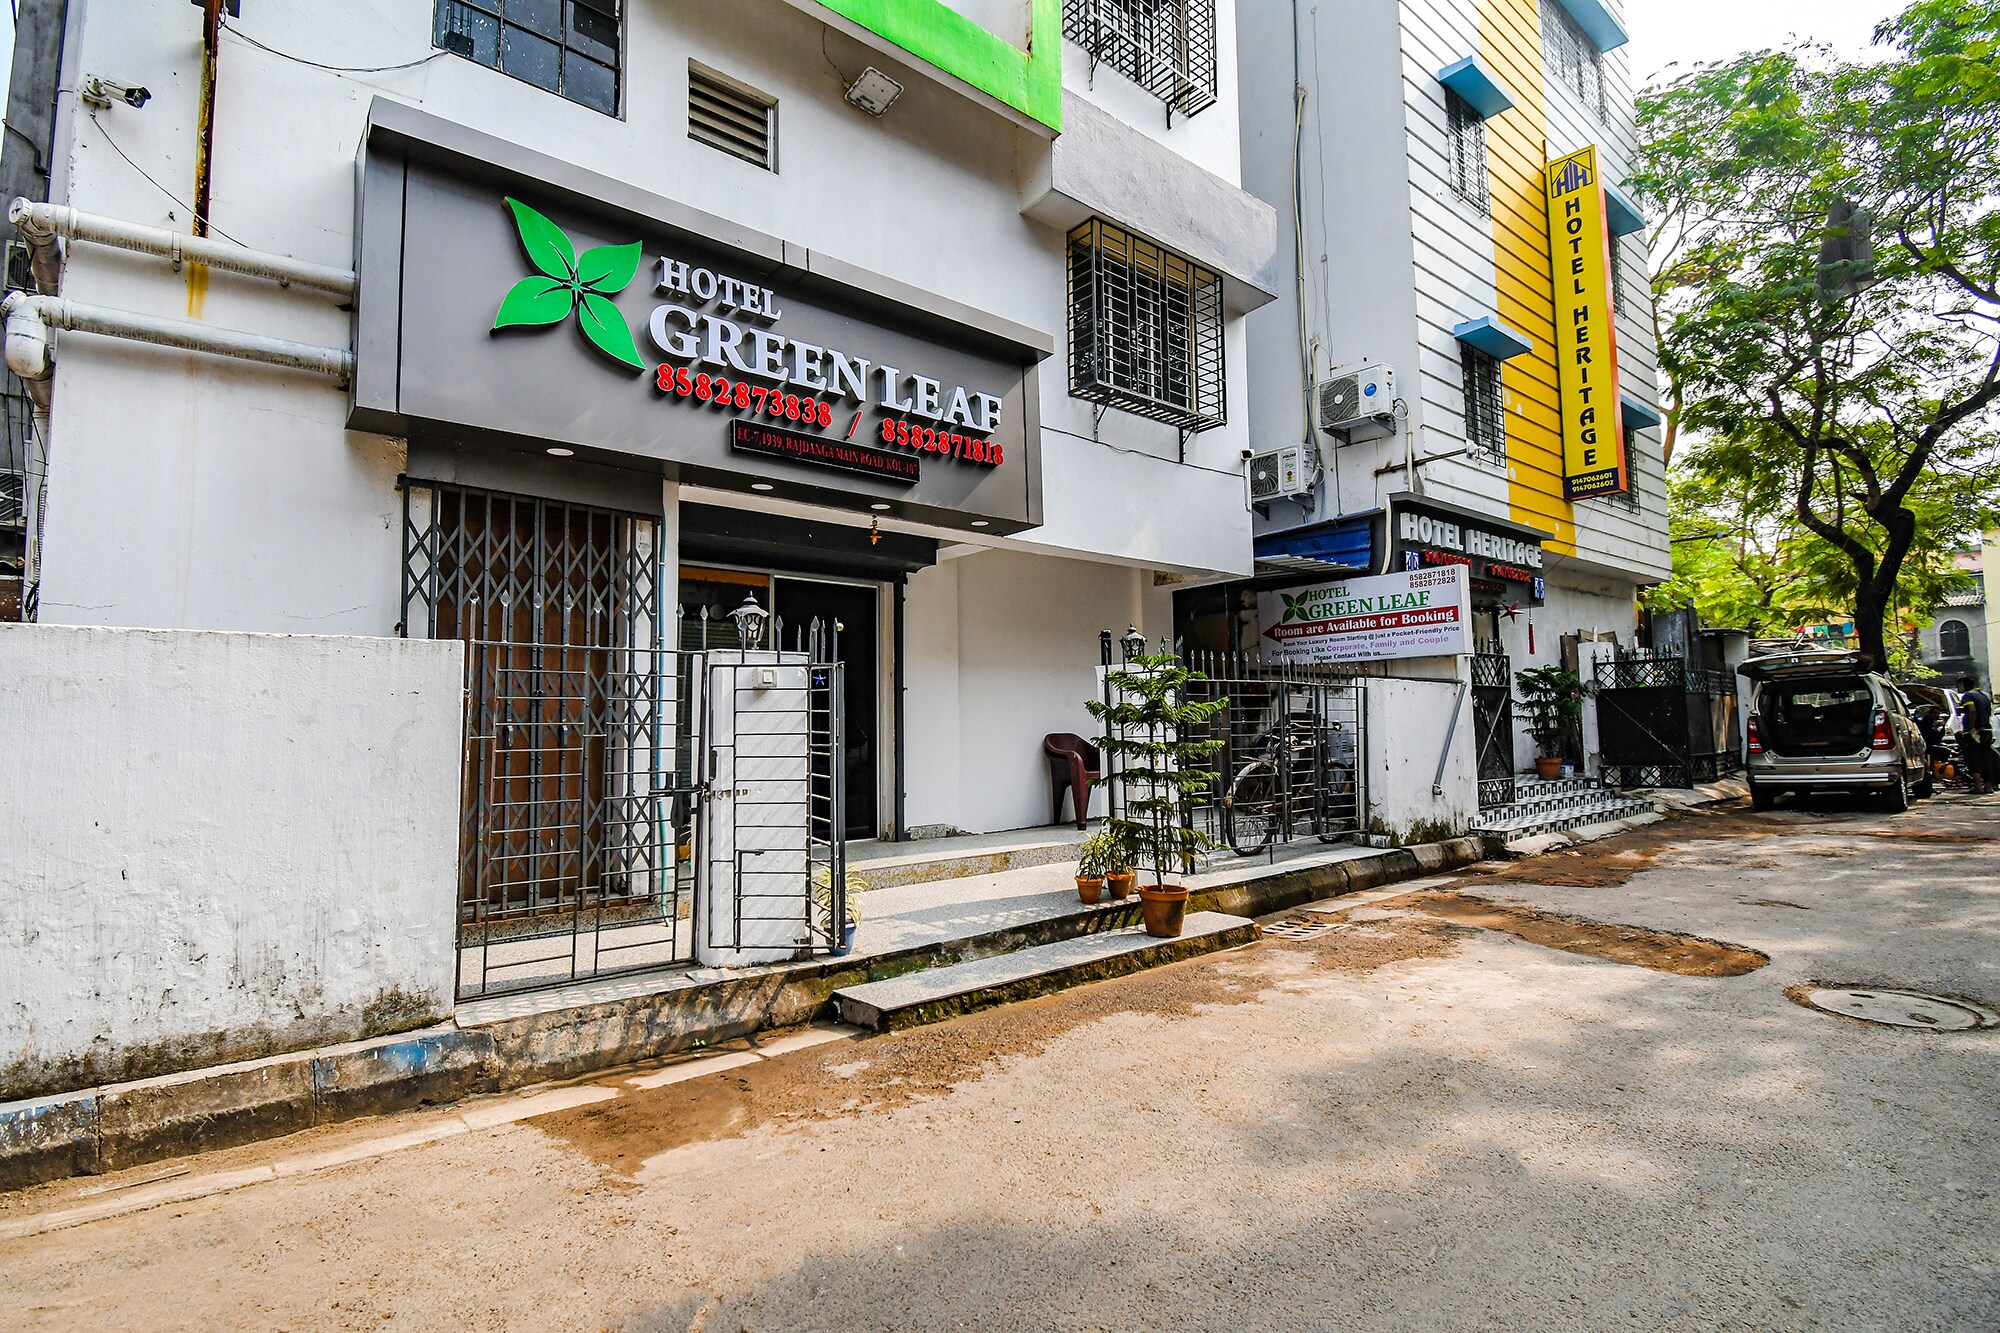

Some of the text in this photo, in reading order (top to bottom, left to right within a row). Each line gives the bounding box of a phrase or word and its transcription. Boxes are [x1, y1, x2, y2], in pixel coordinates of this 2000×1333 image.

[658, 255, 782, 321] HOTEL
[1565, 197, 1597, 467] HOTEL HERITAGE
[648, 303, 1003, 434] GREEN LEAF
[656, 362, 1004, 466] 8582873838 / 8582871818
[786, 437, 834, 458] RAJDANGA
[836, 447, 859, 464] MAIN
[1571, 472, 1613, 486] 9147062601
[1571, 480, 1614, 493] 9147062602
[1400, 512, 1464, 551] HOTEL
[1465, 529, 1543, 569] HERITAGE
[1409, 568, 1456, 581] 8582871818
[1409, 576, 1456, 588] 8582872828
[1308, 586, 1350, 601] HOTEL
[1308, 590, 1431, 619] GREEN LEAF
[1274, 609, 1455, 637] Room are Available for Booking
[1391, 627, 1443, 637] Pocket-Friendly
[1284, 647, 1310, 656] Booking
[1311, 645, 1325, 653] Like
[1326, 643, 1368, 652] Corporate,
[1370, 640, 1397, 649] Family
[1399, 638, 1415, 646] and
[1417, 636, 1449, 644] Couple
